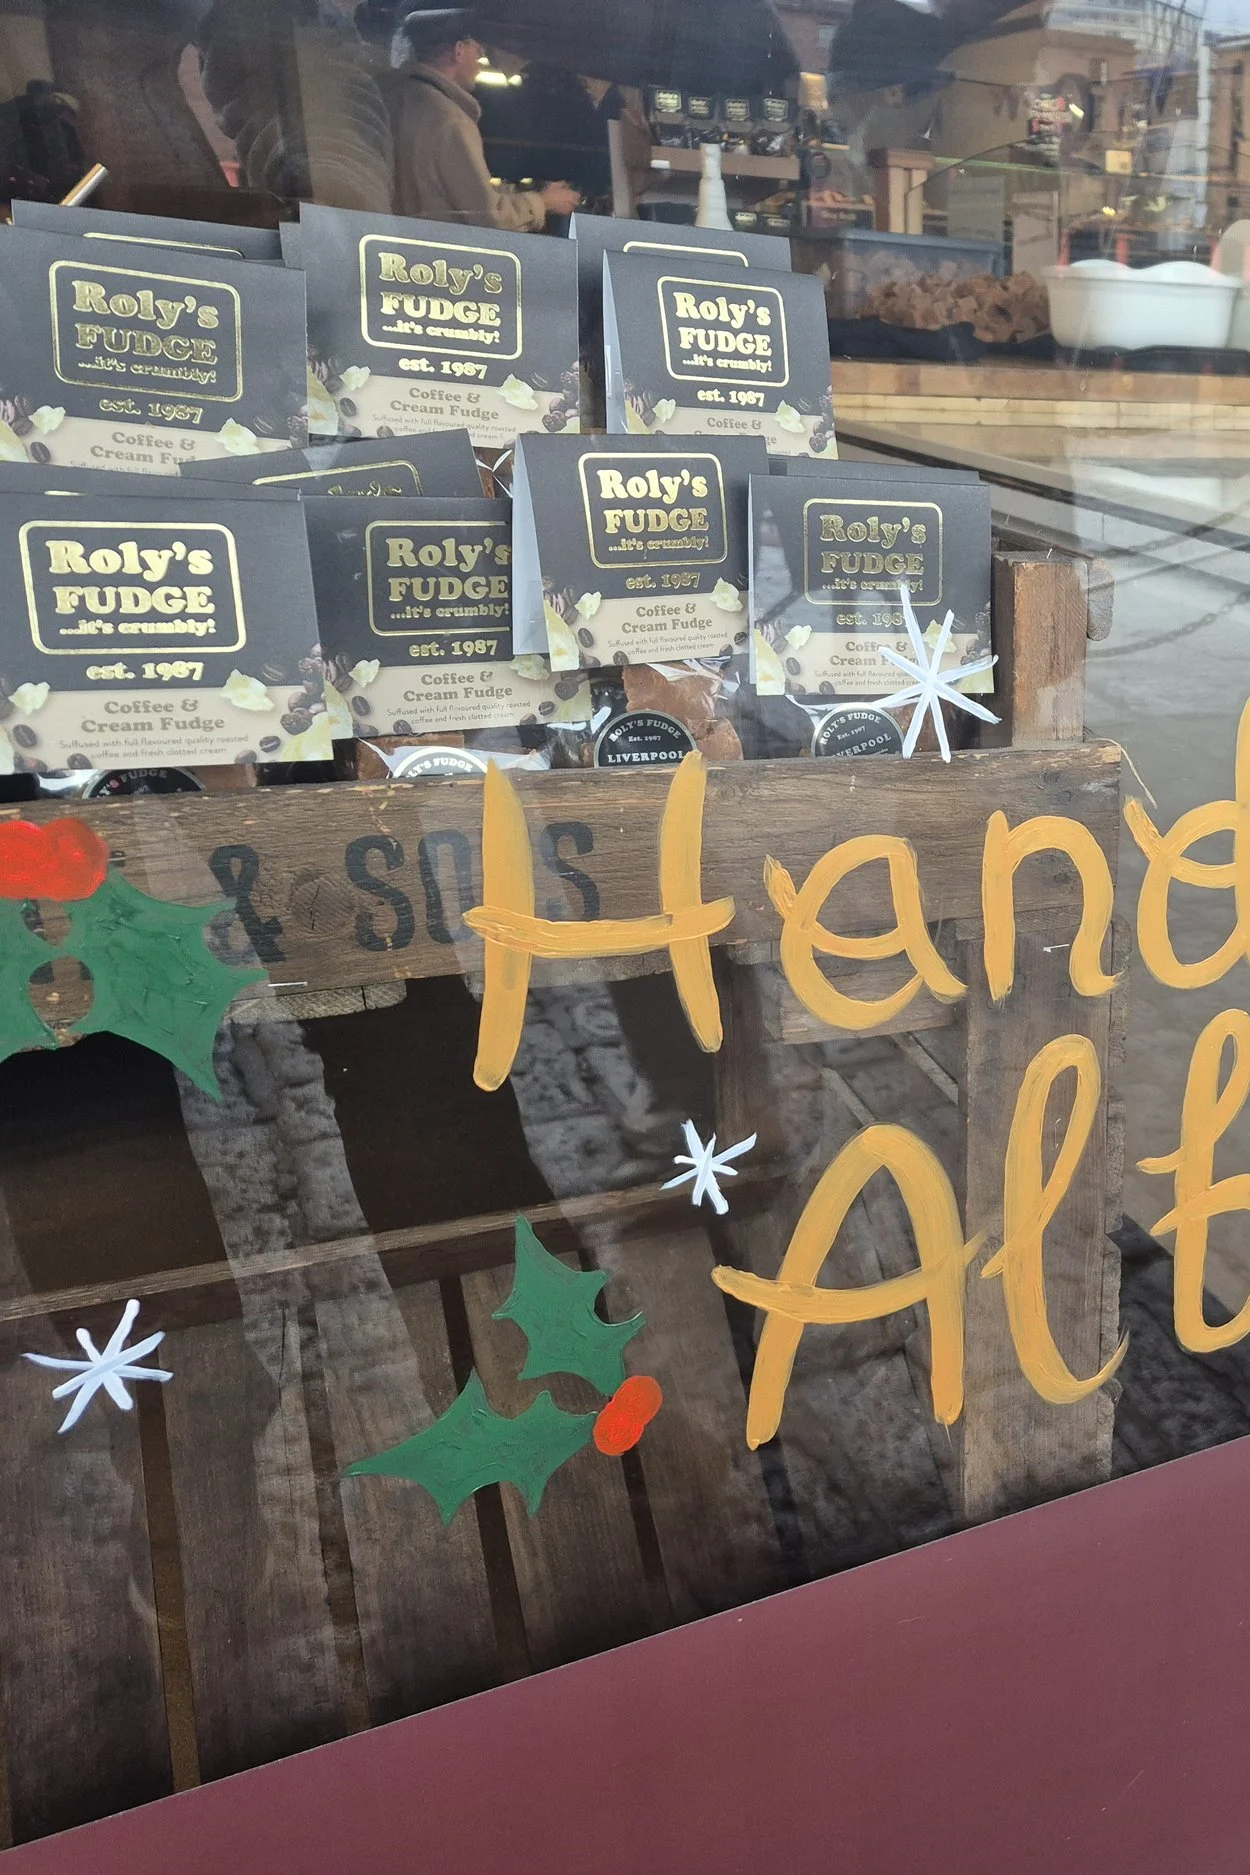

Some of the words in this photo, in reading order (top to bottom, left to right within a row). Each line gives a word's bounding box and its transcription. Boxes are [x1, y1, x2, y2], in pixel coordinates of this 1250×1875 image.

[378, 252, 502, 295] Roly's
[72, 280, 219, 330] Roly's
[380, 291, 501, 326] FUDGE
[673, 292, 771, 329] Roly's
[76, 322, 218, 365] FUDGE
[427, 325, 500, 343] crumbly!
[678, 327, 772, 357] FUDGE
[131, 360, 217, 384] crumbly!
[399, 357, 435, 372] est.
[440, 361, 488, 380] 1987
[716, 357, 772, 373] crumbly!
[409, 387, 461, 402] Coffee
[467, 392, 480, 403] &
[697, 388, 725, 403] est.
[729, 390, 765, 407] 1987
[99, 396, 141, 416] est.
[147, 401, 204, 424] 1987
[390, 400, 444, 416] Cream
[449, 405, 499, 421] Fudge
[706, 417, 748, 430] Coffee
[751, 420, 762, 430] &
[112, 431, 174, 449] Coffee
[179, 438, 196, 450] &
[90, 445, 154, 463] Cream
[597, 468, 708, 505] Roly's
[604, 508, 709, 534] FUDGE
[819, 514, 927, 549] Roly's
[647, 536, 710, 551] crumbly!
[46, 540, 214, 582] Roly's
[385, 537, 512, 572] Roly's
[821, 552, 924, 575] FUDGE
[387, 575, 510, 602] FUDGE
[626, 576, 657, 590] est.
[661, 572, 701, 589] 1987
[53, 586, 215, 614] FUDGE
[435, 603, 510, 620] crumbly!
[636, 605, 681, 617] Coffee
[685, 603, 696, 614] &
[836, 612, 867, 626] est.
[871, 612, 906, 627] 198
[118, 619, 217, 636] crumbly!
[622, 621, 668, 634] Cream
[671, 617, 713, 631] Fudge
[408, 641, 445, 658] est.
[451, 639, 498, 657] 1987
[896, 640, 909, 652] &
[830, 655, 877, 666] Cream
[86, 662, 135, 681] est.
[142, 661, 205, 681] 1987
[420, 672, 475, 686] Coffee
[479, 671, 494, 682] &
[403, 690, 459, 702] Cream
[463, 686, 513, 700] Fudge
[104, 700, 174, 714] Coffee
[181, 699, 199, 712] &
[81, 719, 153, 733] Cream
[160, 716, 225, 731] Fudge
[608, 719, 644, 743] ROLY'S
[646, 719, 682, 739] FUDGE
[820, 716, 847, 745] ROLY'S
[846, 712, 881, 724] FUDGE
[607, 750, 686, 763] LIVERPOOL
[119, 769, 168, 784] FUDGE
